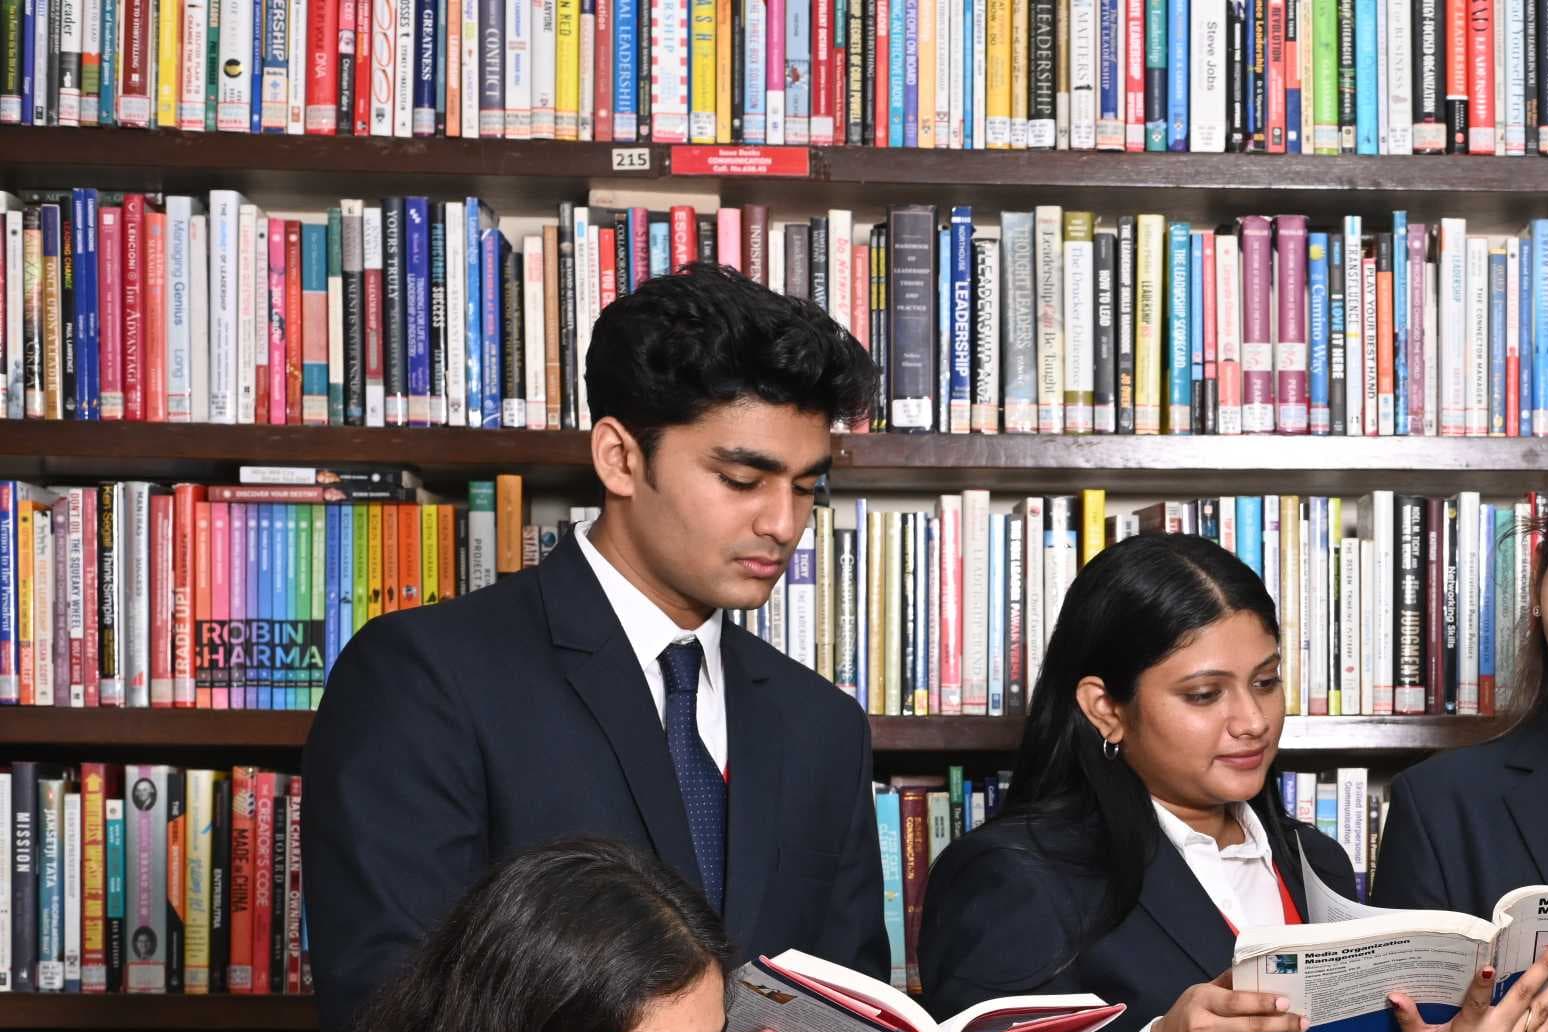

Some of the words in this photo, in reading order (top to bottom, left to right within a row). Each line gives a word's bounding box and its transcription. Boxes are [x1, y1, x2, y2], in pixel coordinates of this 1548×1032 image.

[906, 8, 917, 38] PEOPLE
[1149, 10, 1161, 62] Leadership
[1206, 22, 1217, 56] Steve
[1272, 8, 1282, 62] REVOLUTION
[315, 53, 326, 77] DNA
[422, 10, 432, 80] GREATNESS
[486, 29, 502, 97] CONFLICT
[906, 41, 917, 53] ON
[1037, 4, 1052, 114] LEADERSHIP
[1077, 11, 1090, 81] MATTERS
[618, 33, 632, 113] LEADERSHIP
[906, 56, 917, 84] BOARD
[1206, 61, 1217, 91] Jobs
[1423, 55, 1435, 112] ORGANIZATION
[616, 154, 647, 166] 215
[172, 220, 184, 277] Managing
[387, 210, 398, 253] YOURS
[616, 225, 626, 294] COLLABORATION
[1014, 224, 1030, 287] THOUGHT
[1042, 232, 1055, 303] Leadership
[387, 260, 398, 300] TRULY
[174, 282, 185, 325] Genius
[432, 287, 444, 328] SUCCESS
[1014, 292, 1030, 347] LEADERS
[1044, 305, 1055, 328] Can
[1312, 285, 1325, 340] Camino
[955, 281, 969, 376] LEADERSHIP
[1044, 333, 1055, 347] Be
[173, 349, 184, 378] Long
[1044, 354, 1057, 393] Taught
[1311, 345, 1325, 375] Way
[473, 539, 482, 580] PROJECT
[1446, 566, 1456, 622] Networking
[202, 622, 304, 644] ROBIN
[1010, 604, 1020, 641] PAWAN
[1447, 625, 1456, 648] Skills
[1010, 644, 1020, 680] VERMA
[1400, 610, 1419, 684] JUDGMENT
[16, 813, 30, 872] MISSION
[233, 829, 249, 863] MADE
[257, 799, 269, 867] CREATOR'S
[233, 876, 249, 912] CHINA
[257, 871, 269, 907] CODE
[289, 891, 300, 938] OWNING
[289, 942, 300, 957] UP
[1304, 950, 1338, 959] Media
[1341, 938, 1410, 954] Organization
[1304, 950, 1376, 964] Management
